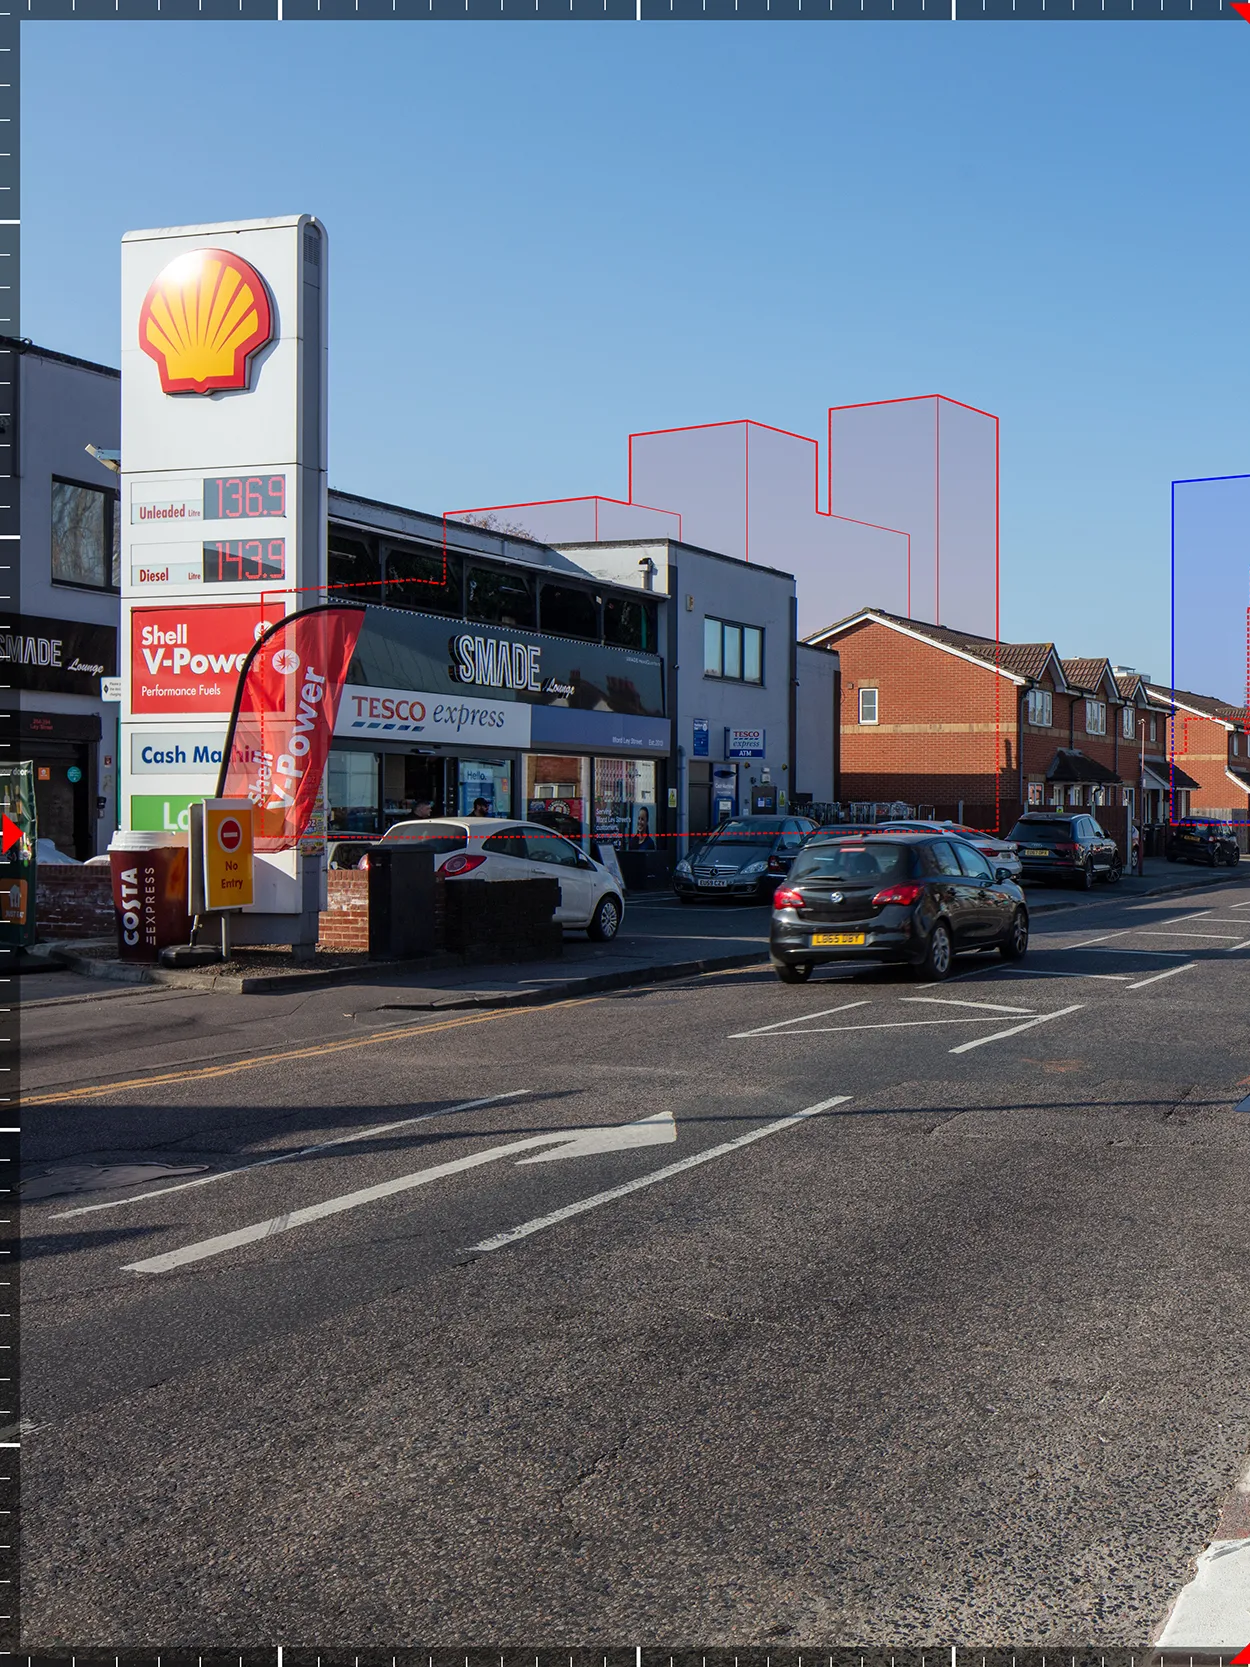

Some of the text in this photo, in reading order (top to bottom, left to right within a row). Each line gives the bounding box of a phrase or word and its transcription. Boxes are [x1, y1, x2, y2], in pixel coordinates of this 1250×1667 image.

[216, 476, 286, 518] 136.9
[139, 504, 201, 520] Unleaded Litre
[216, 540, 286, 581] 143.9
[139, 568, 201, 582] Diesel Litre
[142, 624, 187, 645] Shell
[68, 658, 104, 676] Lounge
[457, 634, 542, 692] SMADE
[142, 683, 221, 697] Performance Fuels
[543, 676, 575, 699] Lounge
[351, 695, 505, 732] TESCO express
[733, 740, 760, 748] express
[142, 745, 186, 763] Cash
[467, 770, 487, 781] Hello.
[225, 860, 239, 871] No
[221, 878, 244, 890] Entry
[121, 867, 157, 946] COSTA EXPRESS
